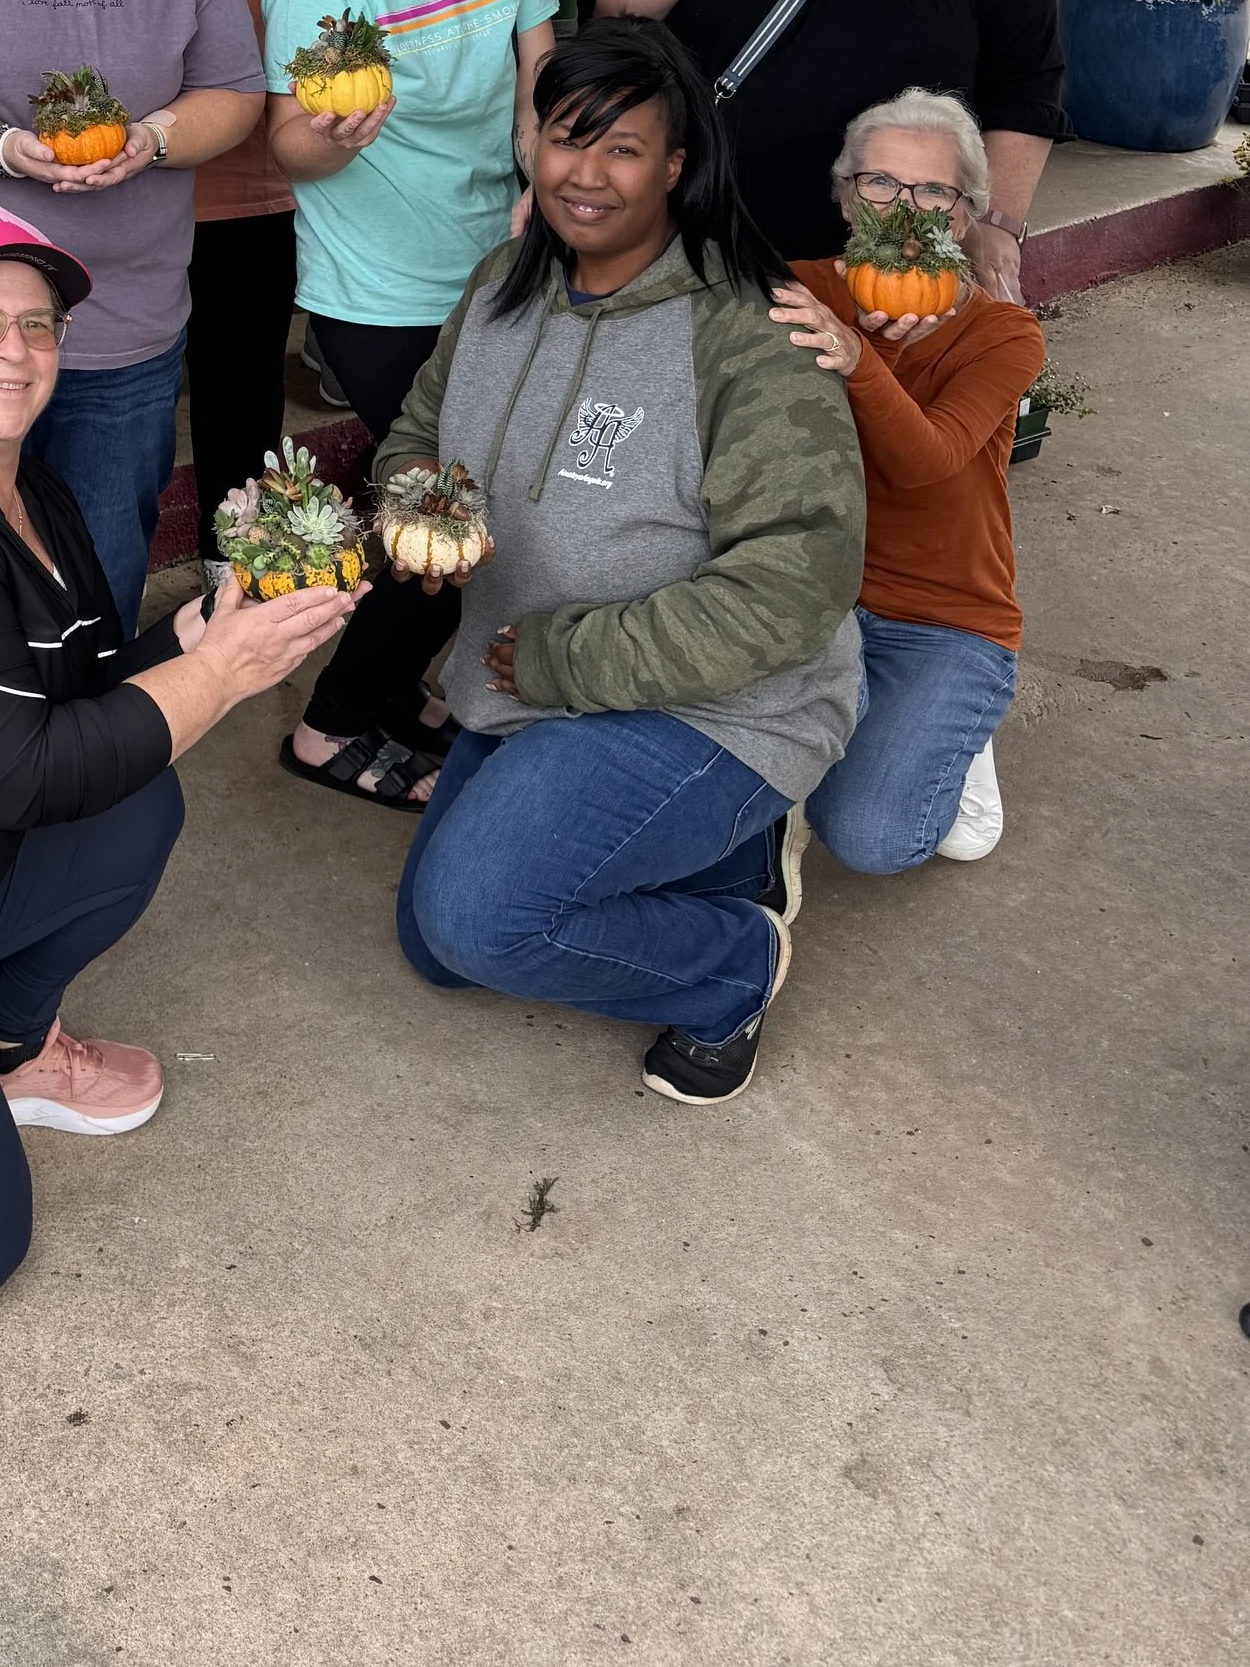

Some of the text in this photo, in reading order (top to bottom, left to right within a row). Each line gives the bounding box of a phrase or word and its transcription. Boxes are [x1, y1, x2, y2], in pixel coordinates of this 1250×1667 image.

[51, 0, 74, 10] fall
[109, 0, 125, 8] all
[392, 32, 442, 54] ILDERNESS
